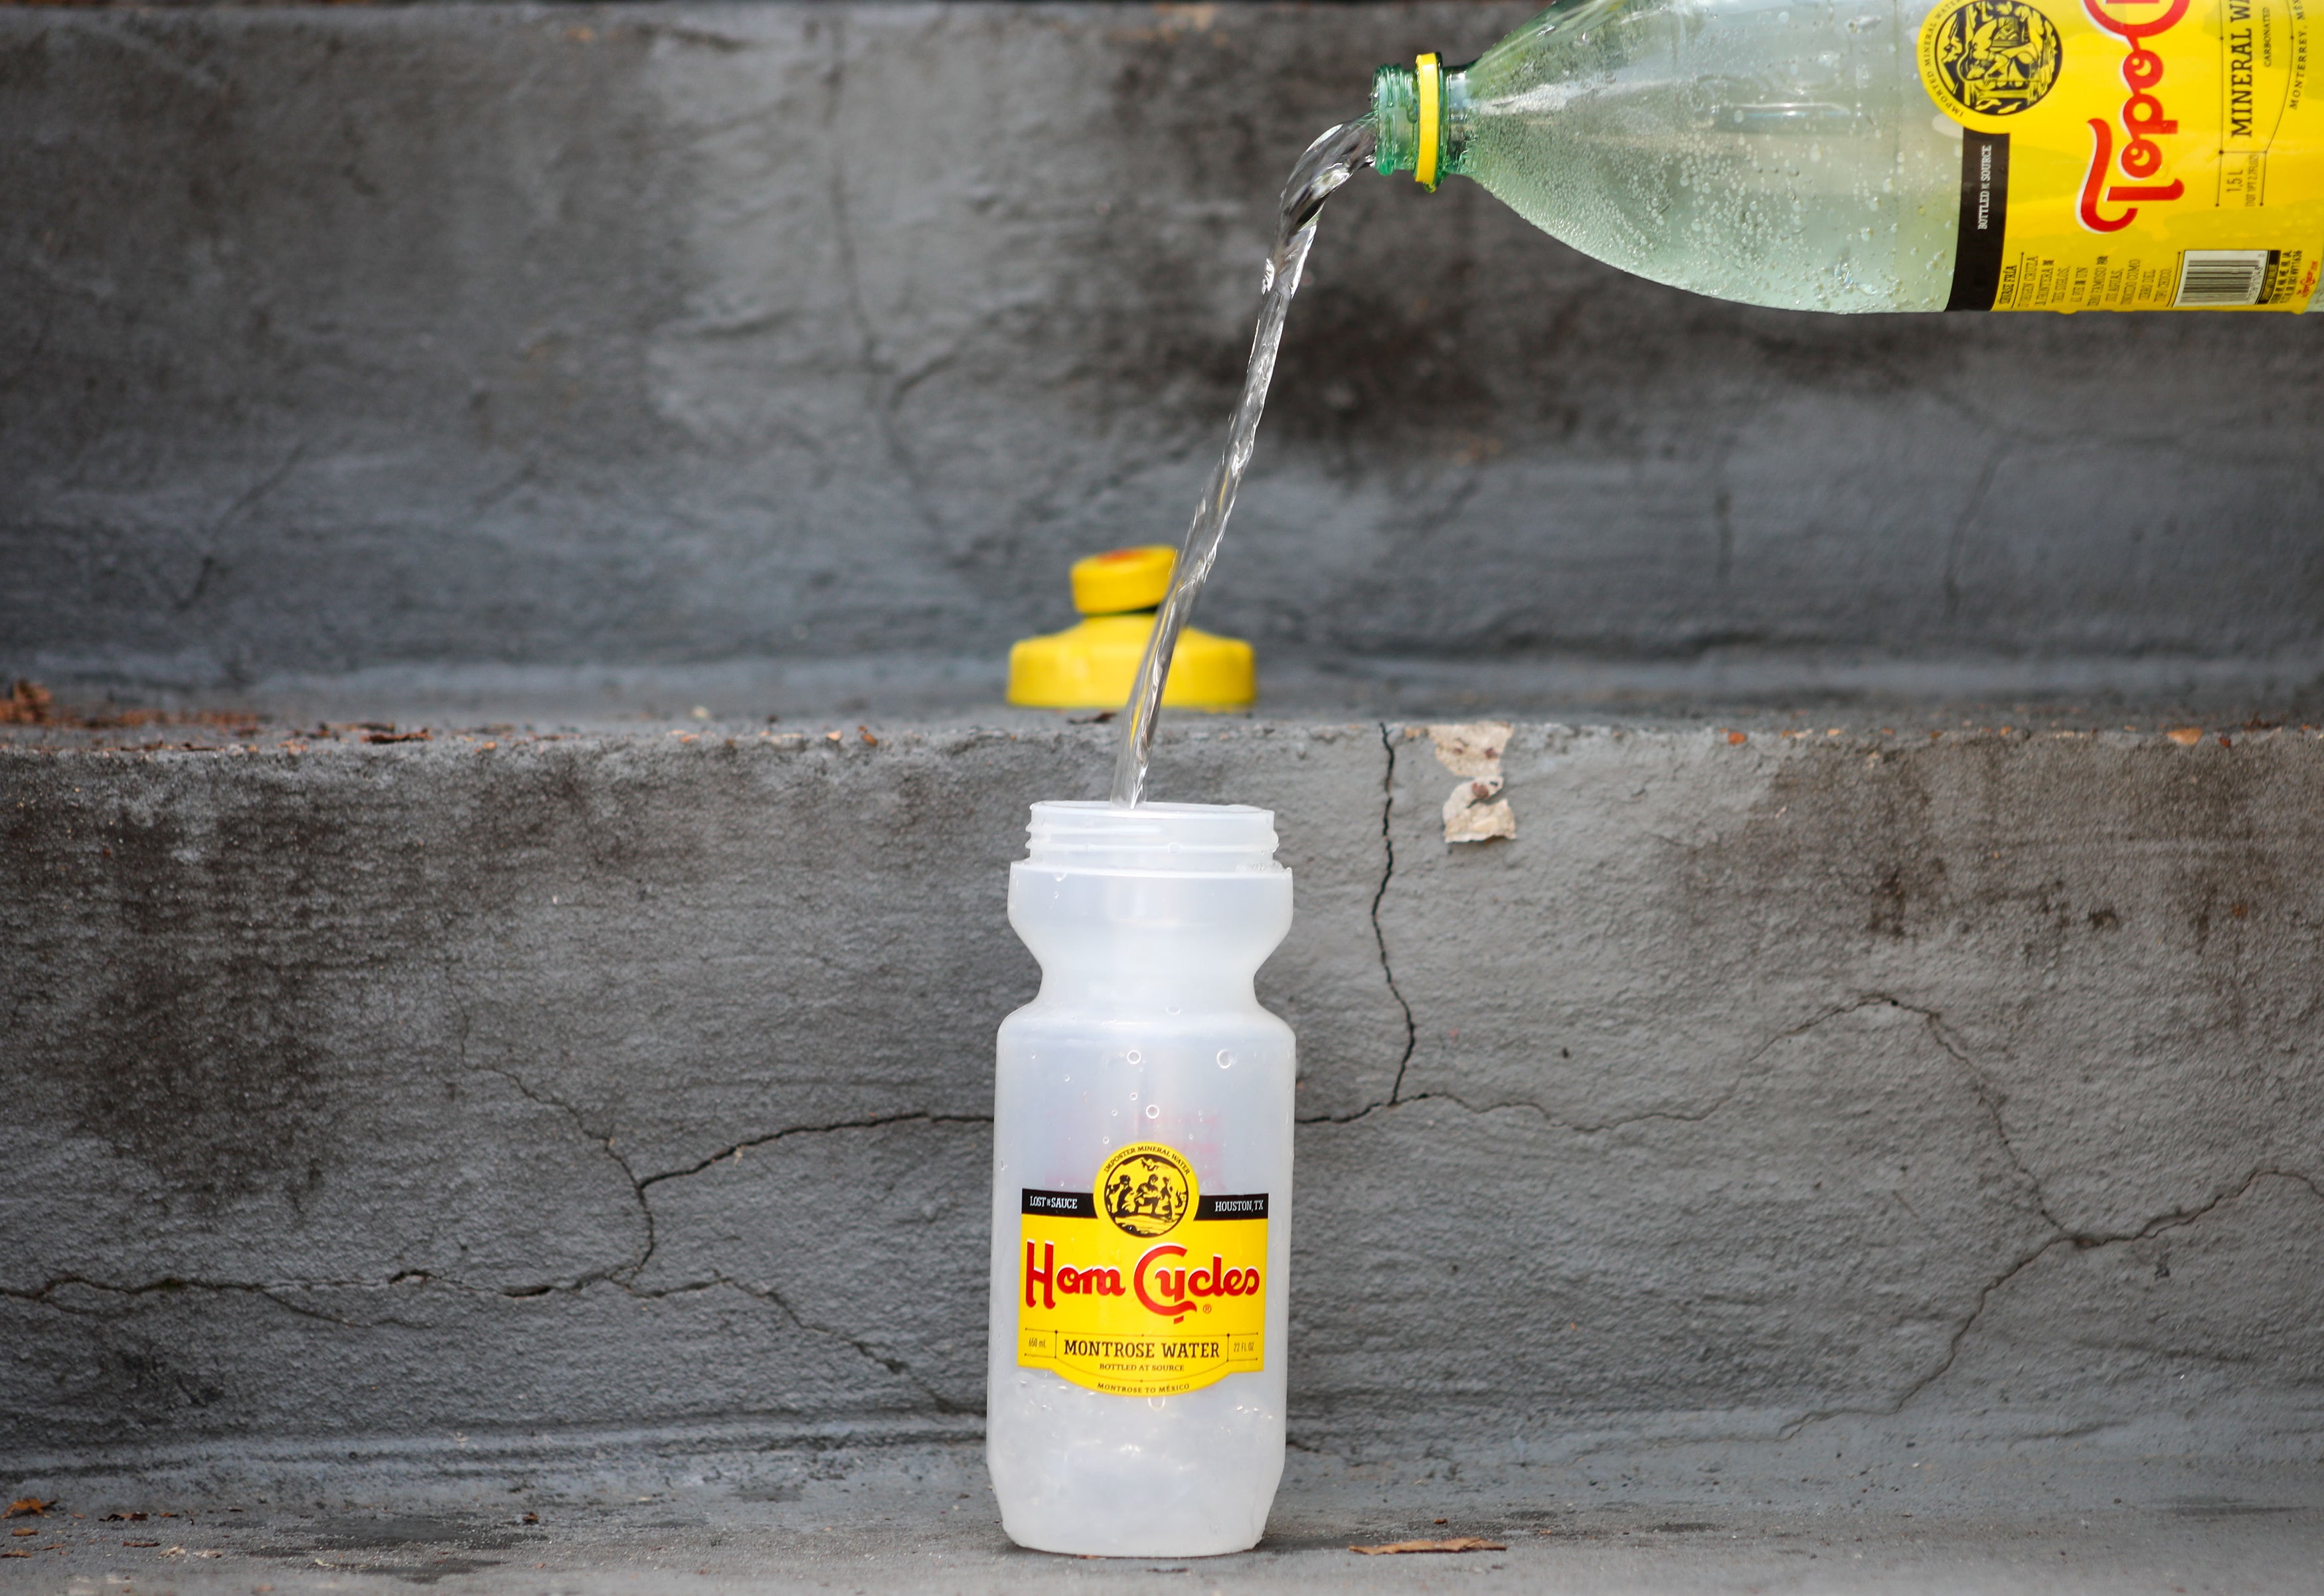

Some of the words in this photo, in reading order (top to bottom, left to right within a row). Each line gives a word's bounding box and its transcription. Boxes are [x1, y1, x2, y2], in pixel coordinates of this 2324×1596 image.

[1935, 0, 1961, 19] WATE
[1924, 23, 1937, 66] MINERAL
[2262, 7, 2272, 68] CARBONATED
[2230, 28, 2252, 138] MINERAL
[2289, 25, 2308, 110] MONTERREY,
[1927, 70, 1964, 118] IMPORTED
[2078, 48, 2185, 234] Topo
[1981, 145, 1992, 182] SOURCE
[1978, 190, 1990, 230] BOTTLED
[1104, 1148, 1136, 1174] IMPOSTER
[1137, 1146, 1170, 1157] MINERAL
[1172, 1153, 1191, 1175] WATER
[1029, 1196, 1046, 1207] LOST
[1051, 1197, 1078, 1209] SAUCE
[1254, 1200, 1264, 1210] TX
[1133, 1243, 1260, 1324] Cycles
[1064, 1339, 1155, 1358] MONTROSE
[1162, 1342, 1220, 1358] WATER
[1097, 1382, 1142, 1394] MONTROSE
[1159, 1384, 1190, 1393] MÉXICO
